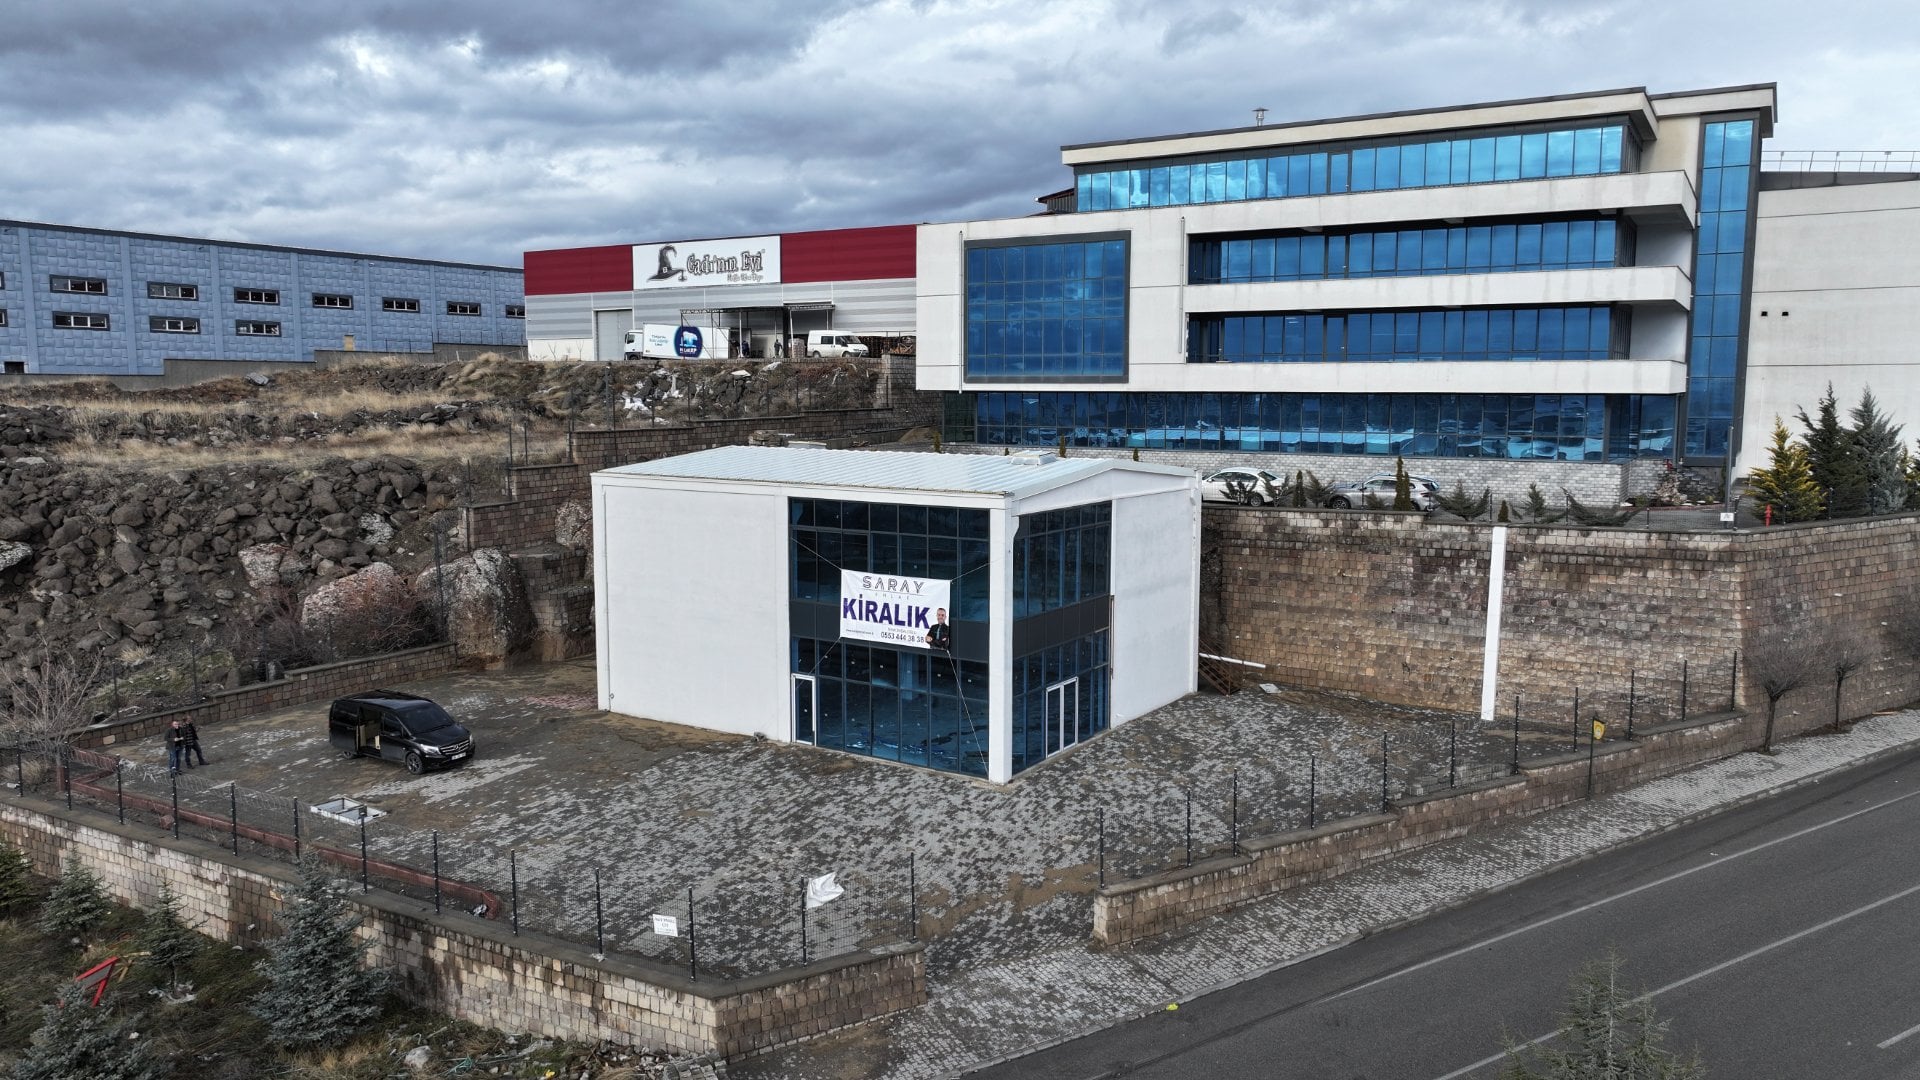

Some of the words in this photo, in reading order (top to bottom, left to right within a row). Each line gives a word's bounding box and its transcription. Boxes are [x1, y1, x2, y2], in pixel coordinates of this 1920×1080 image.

[863, 576, 925, 594] SARAY
[843, 594, 930, 629] KİRALIK
[881, 631, 895, 640] 0553
